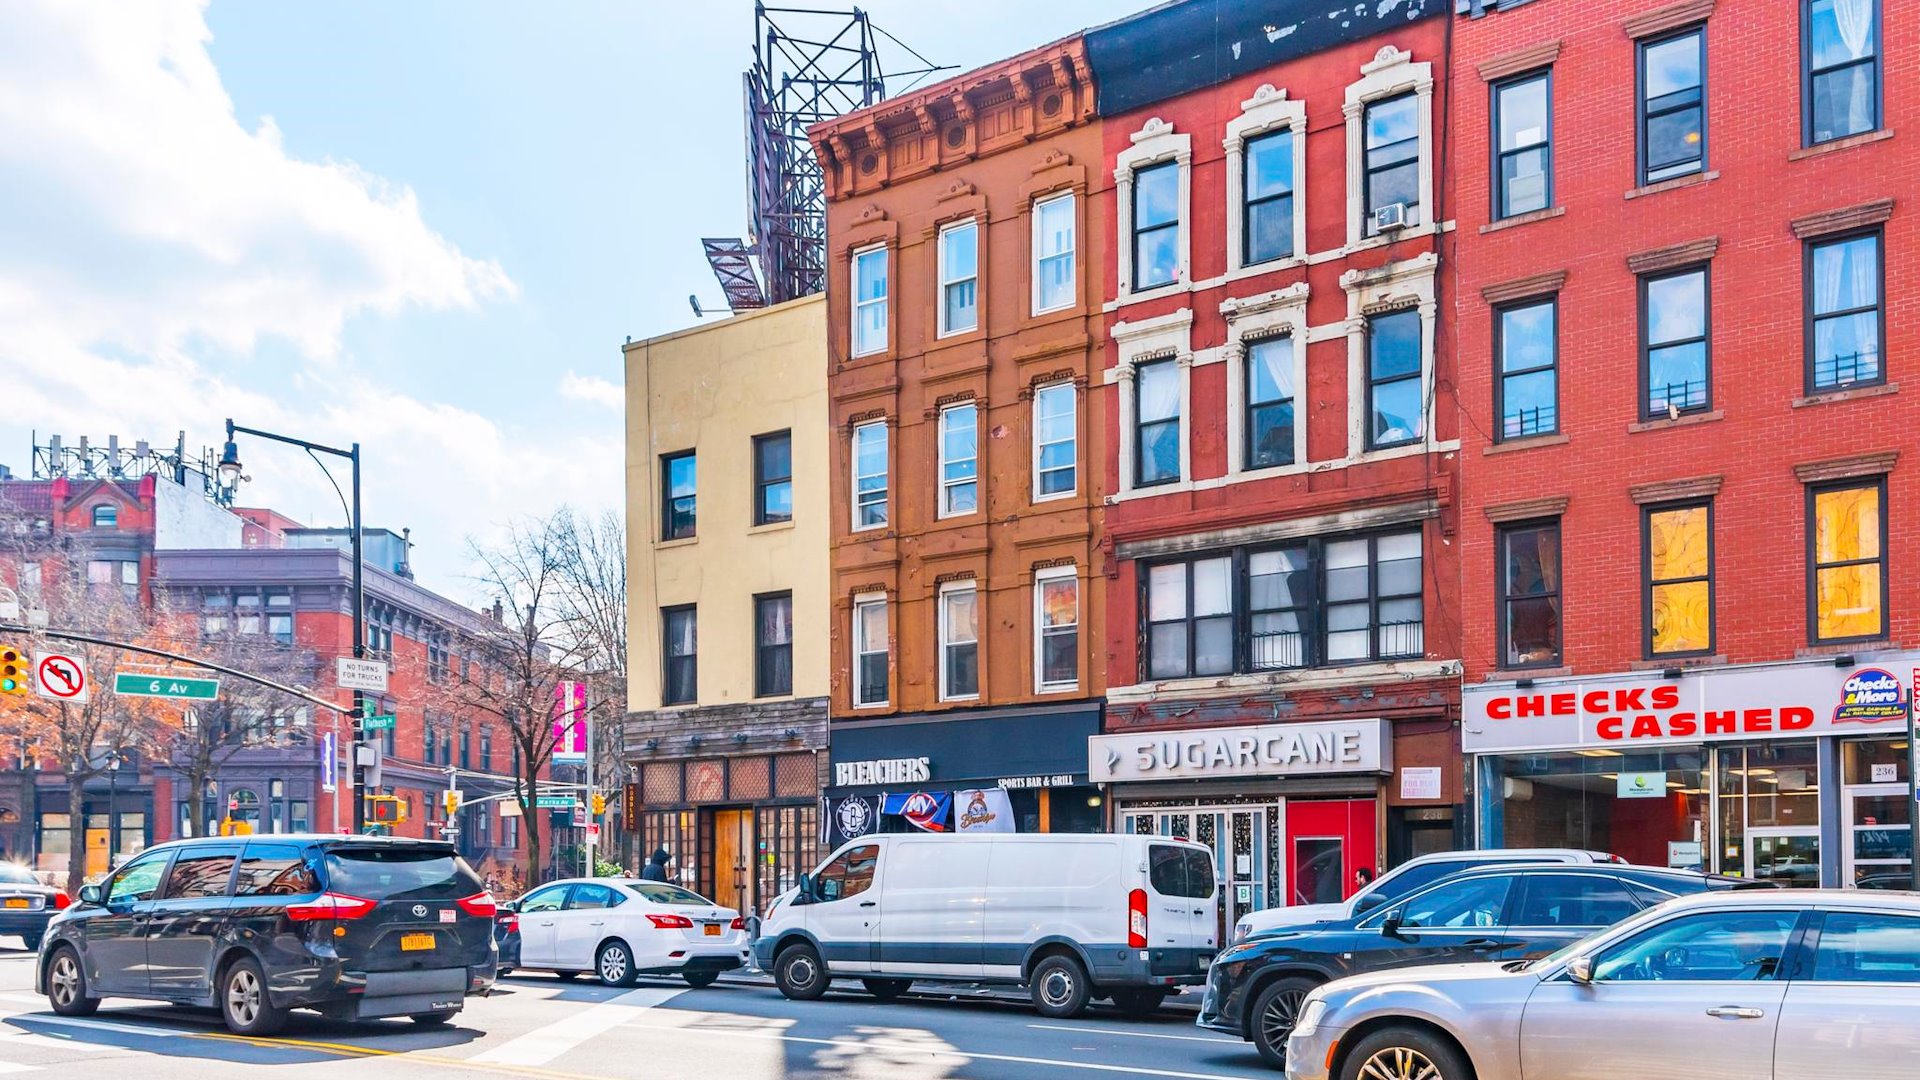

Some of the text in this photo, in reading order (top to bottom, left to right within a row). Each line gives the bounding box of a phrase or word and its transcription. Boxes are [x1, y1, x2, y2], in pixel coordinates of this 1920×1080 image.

[358, 673, 383, 681] TRUCKS
[1845, 676, 1898, 691] Checks
[149, 681, 188, 693] 6 Av
[1486, 686, 1679, 719] CHECKS
[365, 718, 387, 728] Flatbush
[1597, 706, 1814, 739] CASHED
[1137, 730, 1361, 771] SUGARCANE
[835, 757, 931, 786] BLEACHERS
[1876, 767, 1894, 776] 236
[997, 774, 1074, 789] SPORTS BAR & GRILL
[1240, 888, 1248, 899] B
